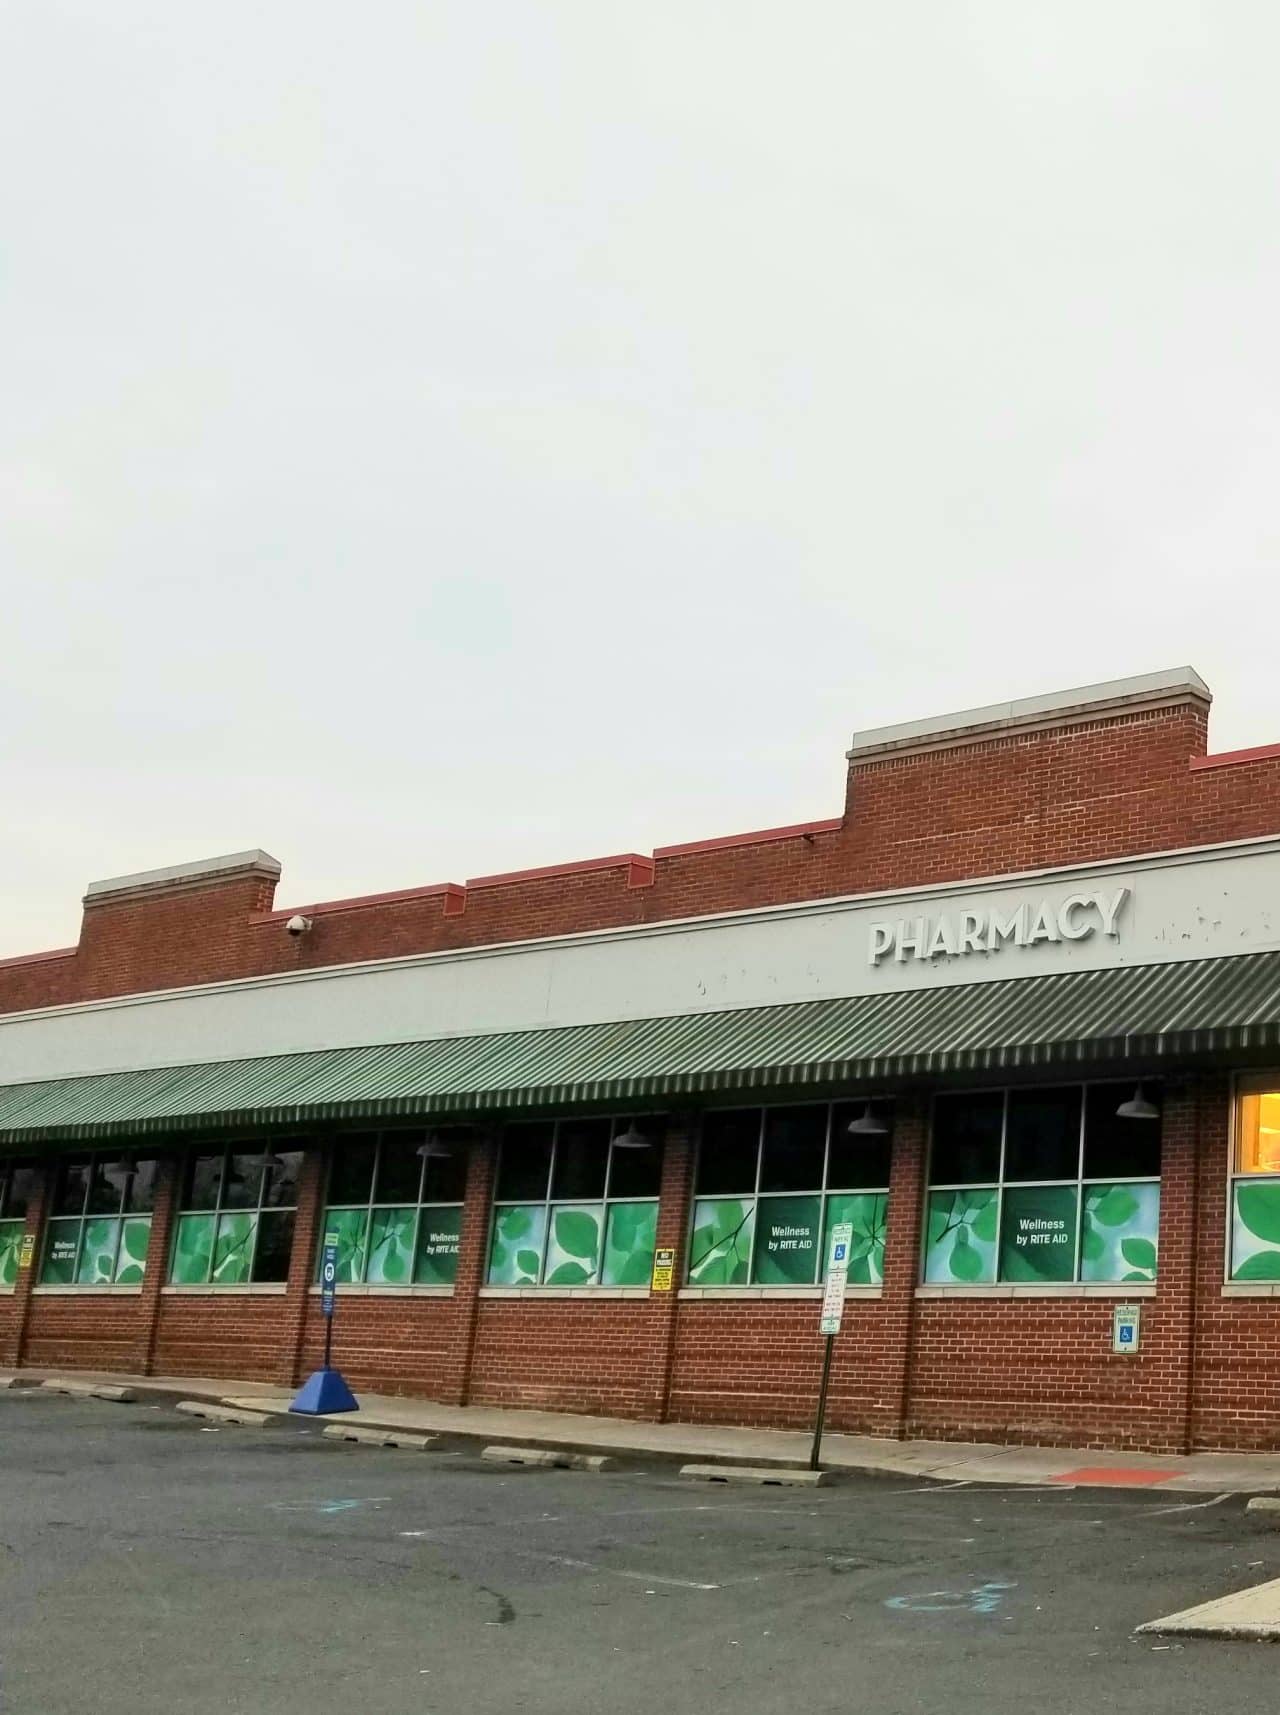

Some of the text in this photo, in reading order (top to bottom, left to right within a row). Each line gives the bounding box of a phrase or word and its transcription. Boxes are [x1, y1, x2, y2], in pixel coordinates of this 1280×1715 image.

[868, 887, 1131, 967] PHARMACY
[1020, 1218, 1065, 1230] Wellness
[430, 1232, 460, 1242] Wellness
[771, 1226, 810, 1237] Wellness
[1016, 1233, 1068, 1246] by RITE AID
[768, 1240, 812, 1251] by RITE AID
